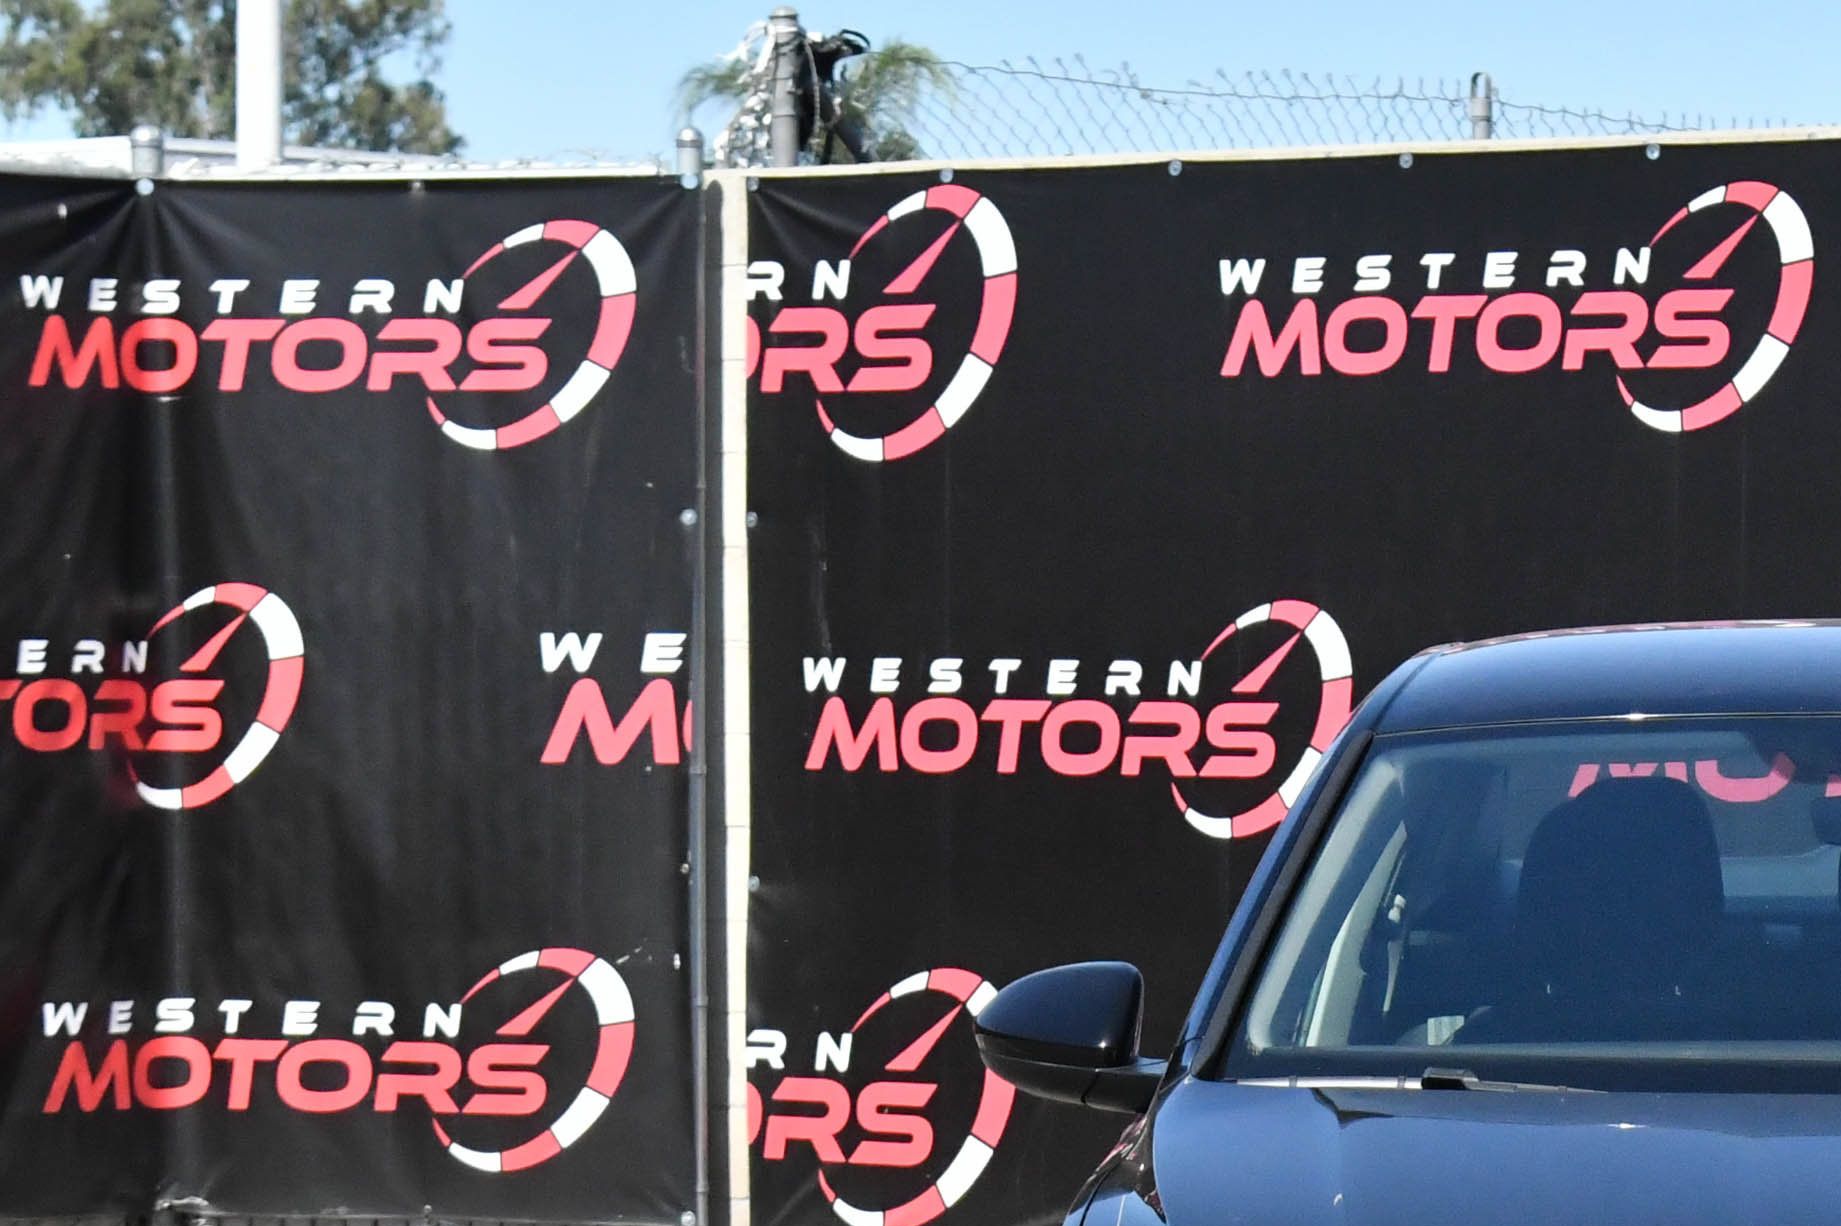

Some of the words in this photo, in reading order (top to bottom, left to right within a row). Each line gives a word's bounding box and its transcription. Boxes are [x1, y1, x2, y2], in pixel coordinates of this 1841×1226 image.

[20, 275, 464, 314] WESTERN
[1220, 247, 1651, 296] WESTERN
[28, 315, 552, 392] MOTORS
[1221, 289, 1734, 377] MOTORS
[803, 657, 1202, 696] WESTERN
[805, 696, 1279, 778] MOTORS
[43, 998, 462, 1038] WESTERN
[43, 1035, 550, 1115] MOTORS
